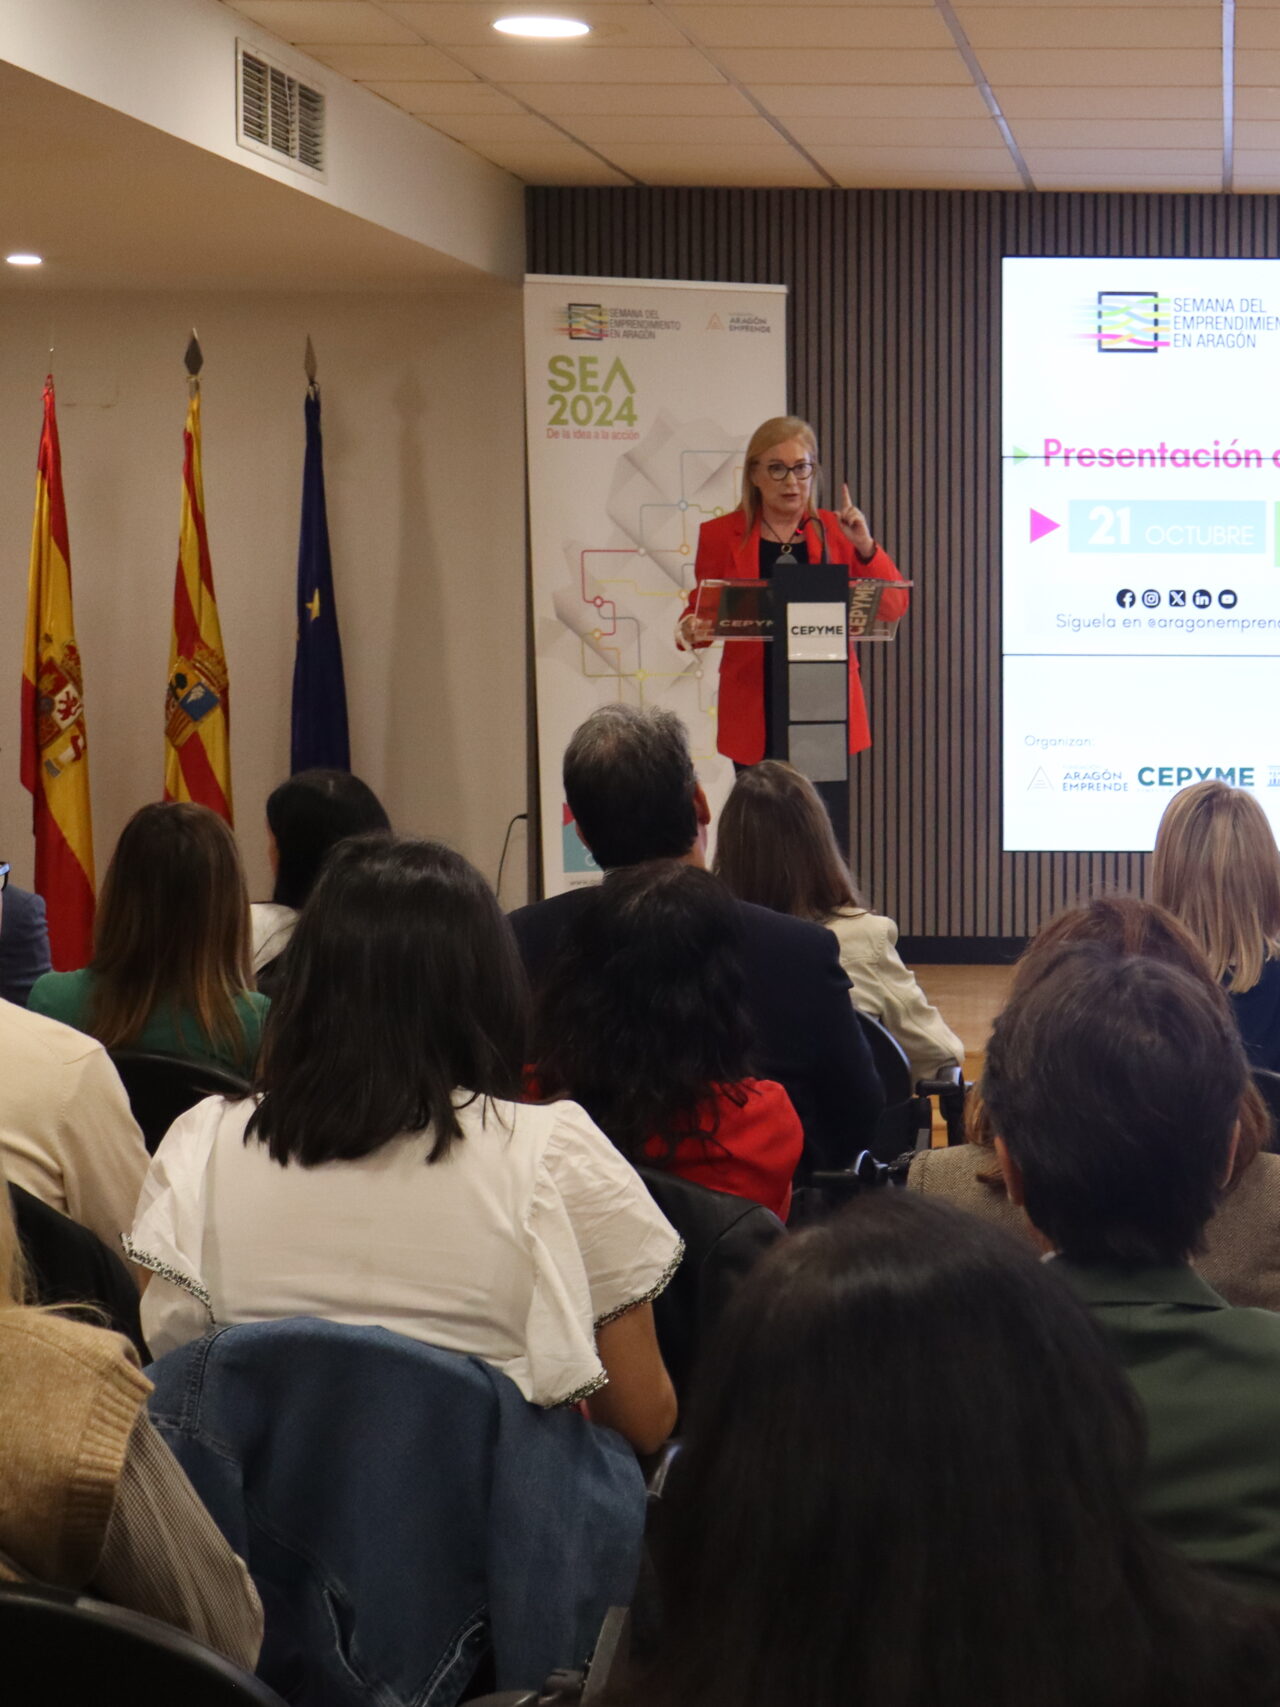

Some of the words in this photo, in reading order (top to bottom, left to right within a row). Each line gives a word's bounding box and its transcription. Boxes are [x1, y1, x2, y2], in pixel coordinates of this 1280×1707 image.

[1173, 297, 1235, 313] SEMANA
[1240, 298, 1267, 313] DEL
[609, 308, 643, 319] SEMANA
[645, 309, 659, 320] DEL
[609, 319, 681, 331] EMPRENDIMIENTO
[609, 329, 620, 339] EN
[1173, 333, 1192, 348] EN
[1196, 331, 1256, 349] ARAGÓN
[547, 355, 636, 394] SEA
[547, 394, 638, 427] 2024
[546, 427, 560, 439] De
[1043, 438, 1263, 468] Presentación
[1087, 505, 1131, 545] 21
[1145, 525, 1255, 546] OCTUBRE
[1122, 617, 1142, 629] en
[791, 625, 844, 636] CEPYME
[1063, 769, 1123, 781] ARAGÓN
[1137, 766, 1255, 787] CEPYME
[1062, 782, 1129, 792] EMPRENDE
